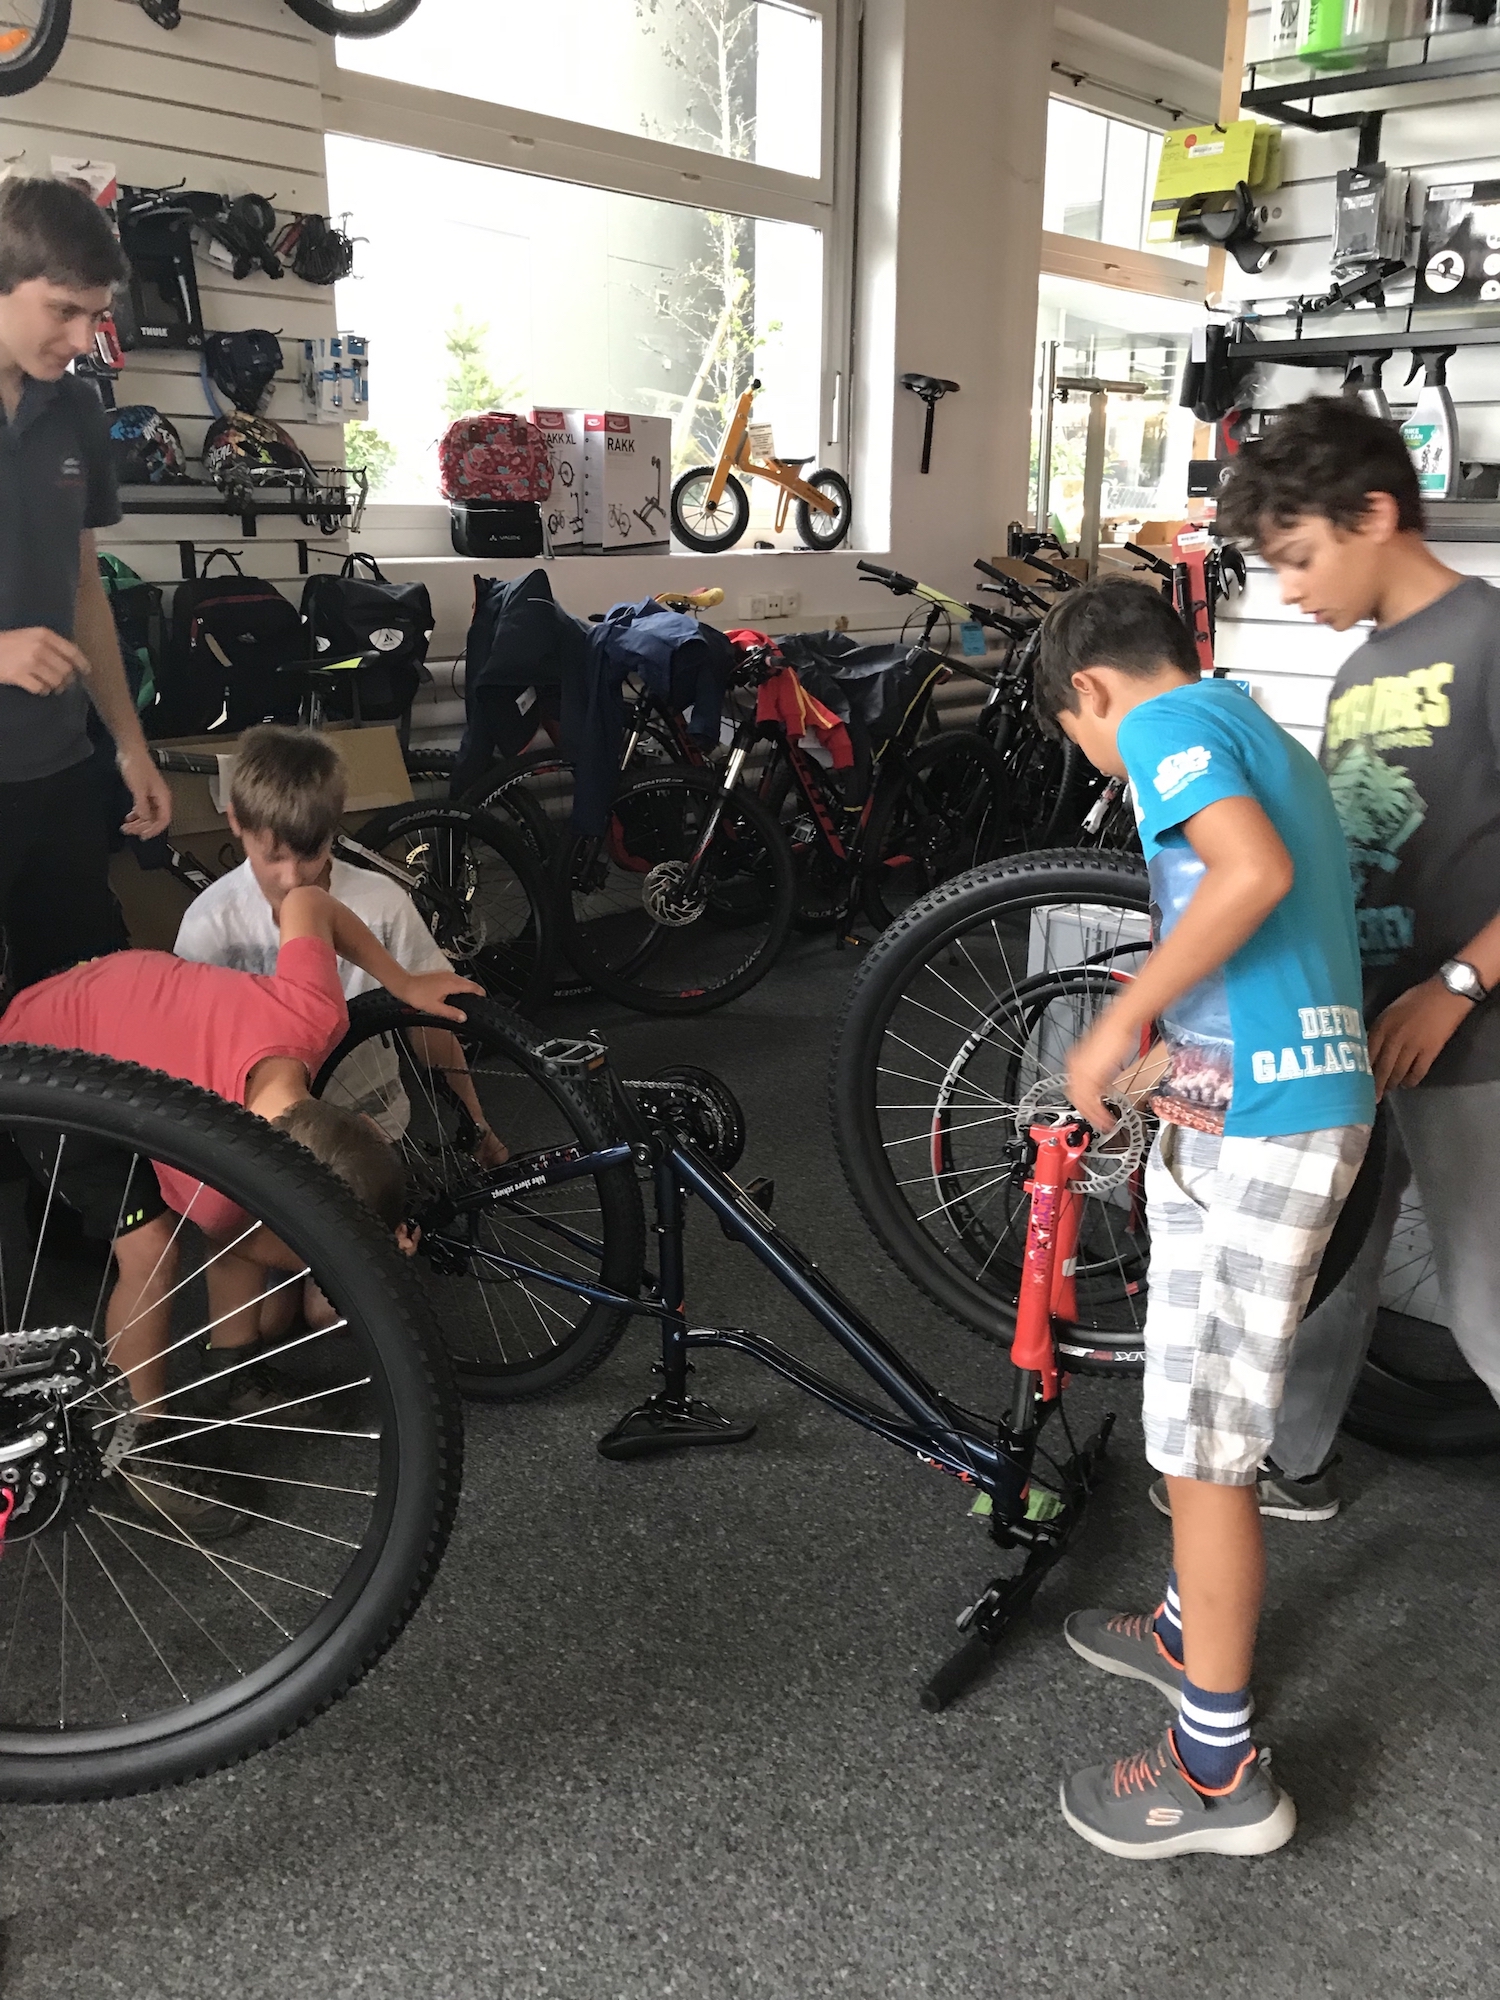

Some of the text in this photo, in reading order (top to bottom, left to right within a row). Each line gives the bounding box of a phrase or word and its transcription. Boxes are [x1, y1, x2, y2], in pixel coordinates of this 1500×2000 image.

[141, 326, 168, 337] THULE
[543, 433, 577, 445] AKK XL
[607, 437, 635, 452] RAKK
